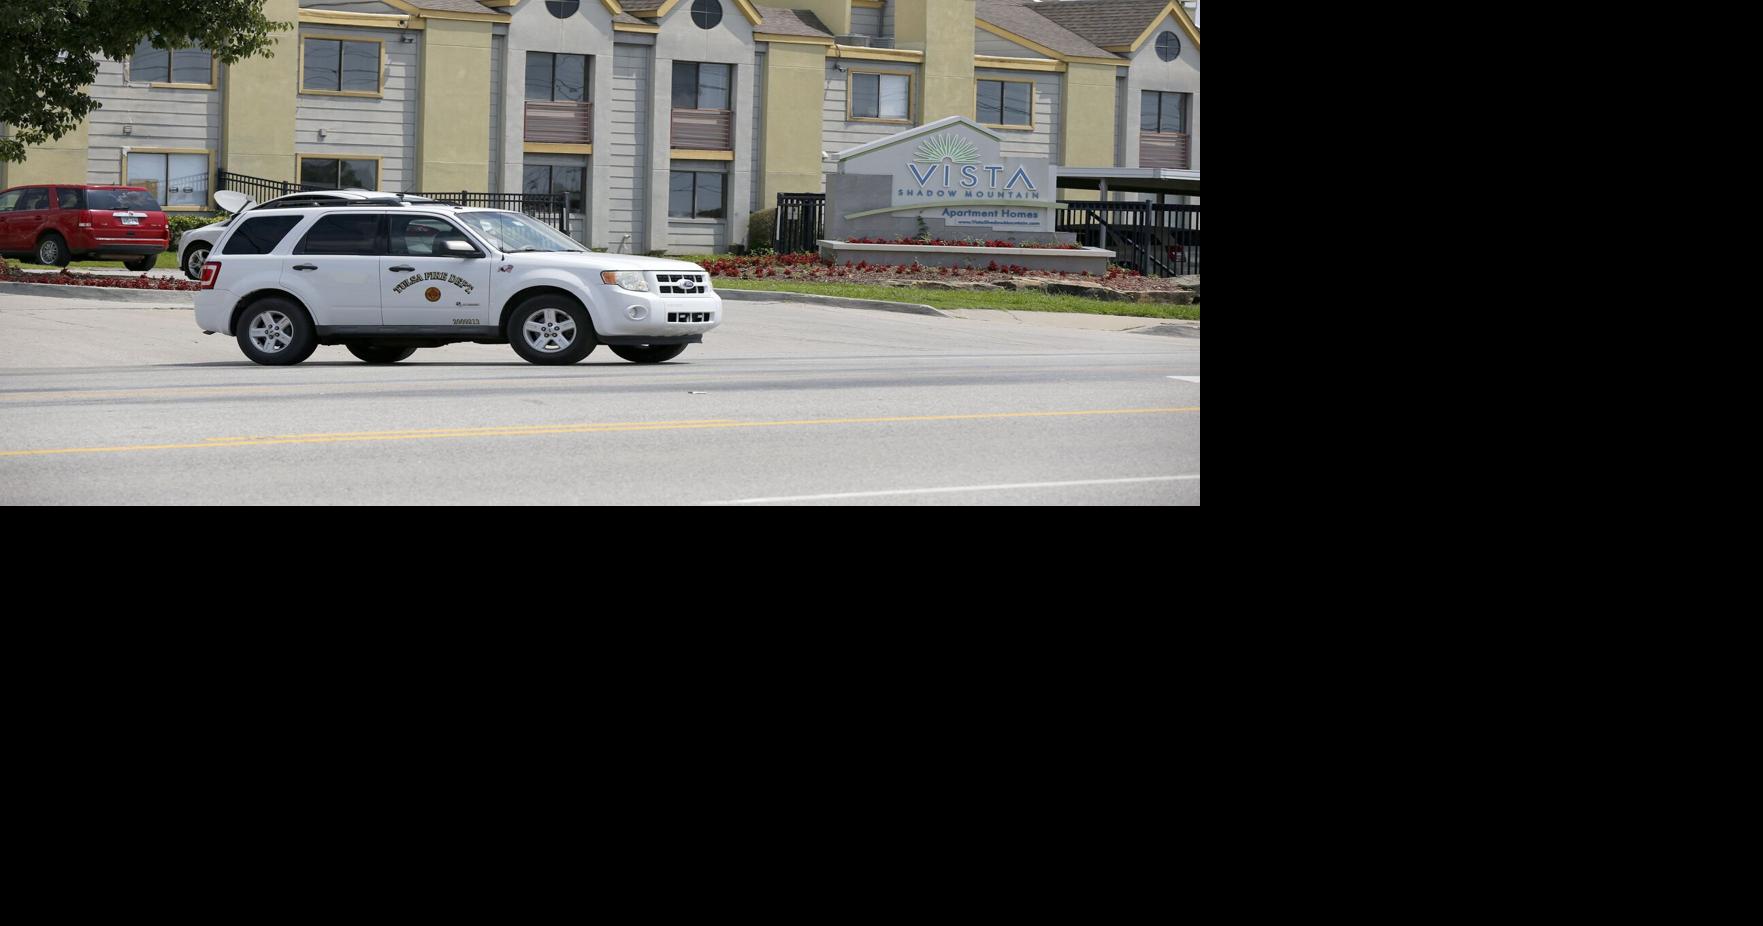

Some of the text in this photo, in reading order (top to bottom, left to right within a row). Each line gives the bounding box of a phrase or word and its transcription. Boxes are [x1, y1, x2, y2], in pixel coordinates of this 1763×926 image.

[908, 162, 1037, 190] VISTA
[897, 189, 1040, 200] SHADOW MOUNTAIN
[942, 208, 1038, 218] Apartment Homes
[392, 273, 423, 294] TULSA
[423, 271, 448, 281] FIRE
